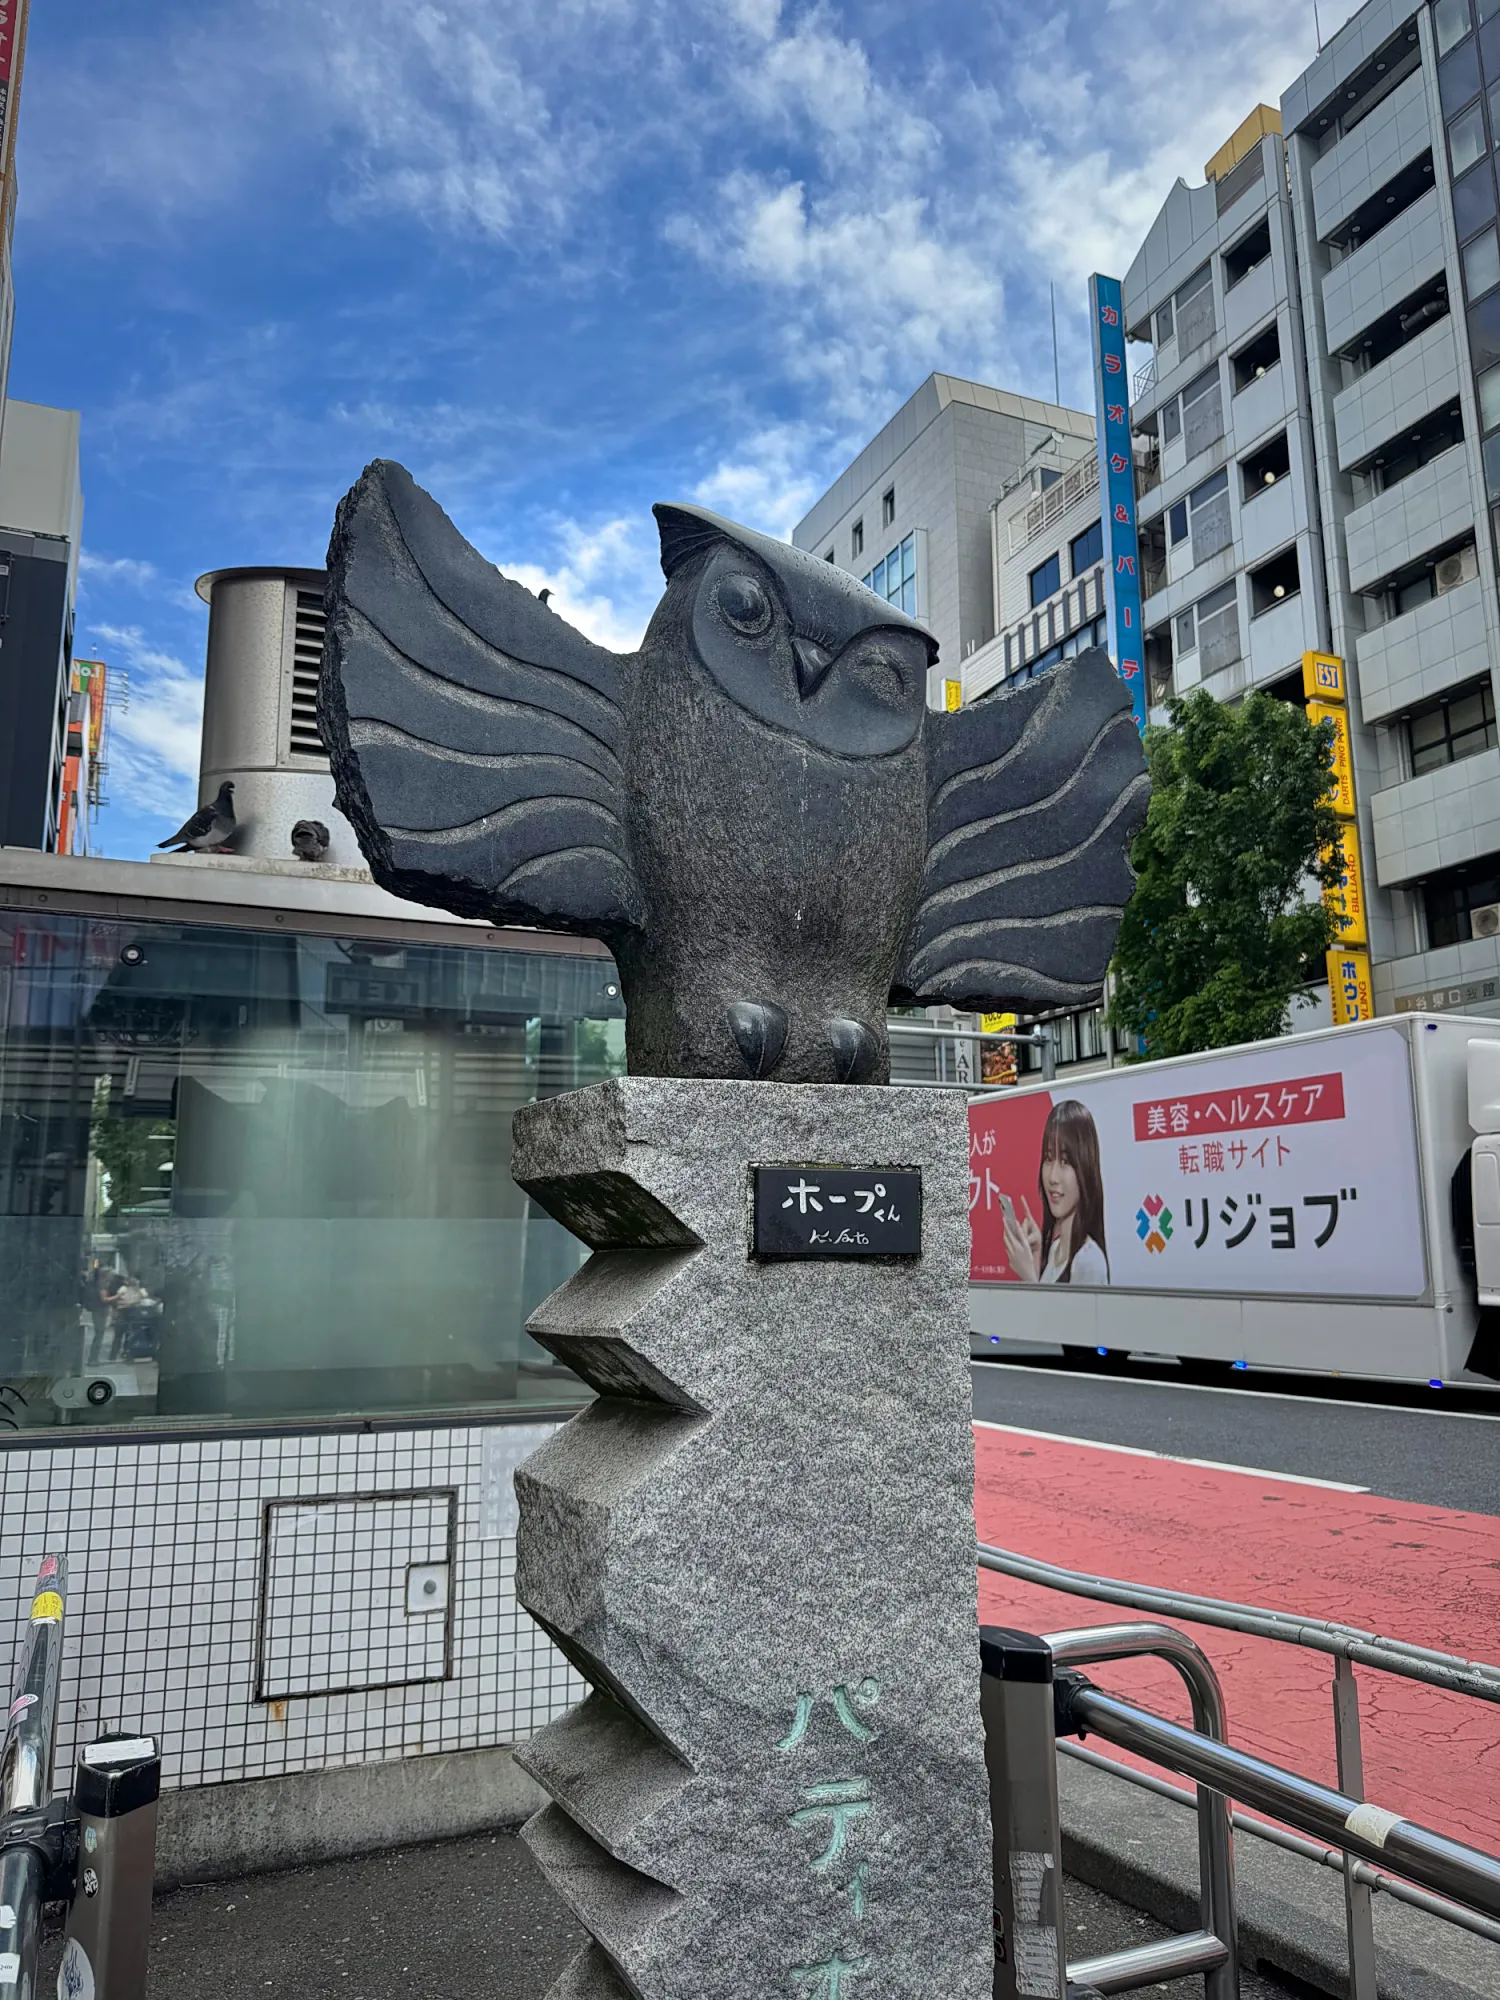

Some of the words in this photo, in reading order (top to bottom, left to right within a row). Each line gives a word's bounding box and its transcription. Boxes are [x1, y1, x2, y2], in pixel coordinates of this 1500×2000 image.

[1101, 305, 1143, 724] カラオケ&パーテ
[1317, 664, 1337, 688] EST
[1337, 745, 1346, 768] PING
[1340, 774, 1350, 805] DARTS
[1348, 853, 1360, 914] BILLIARD
[1146, 1083, 1325, 1136] 美容・ヘルスケア
[1178, 1135, 1292, 1175] 転職サイト
[781, 1177, 900, 1223] ホープくん
[1184, 1187, 1358, 1250] リジョブ
